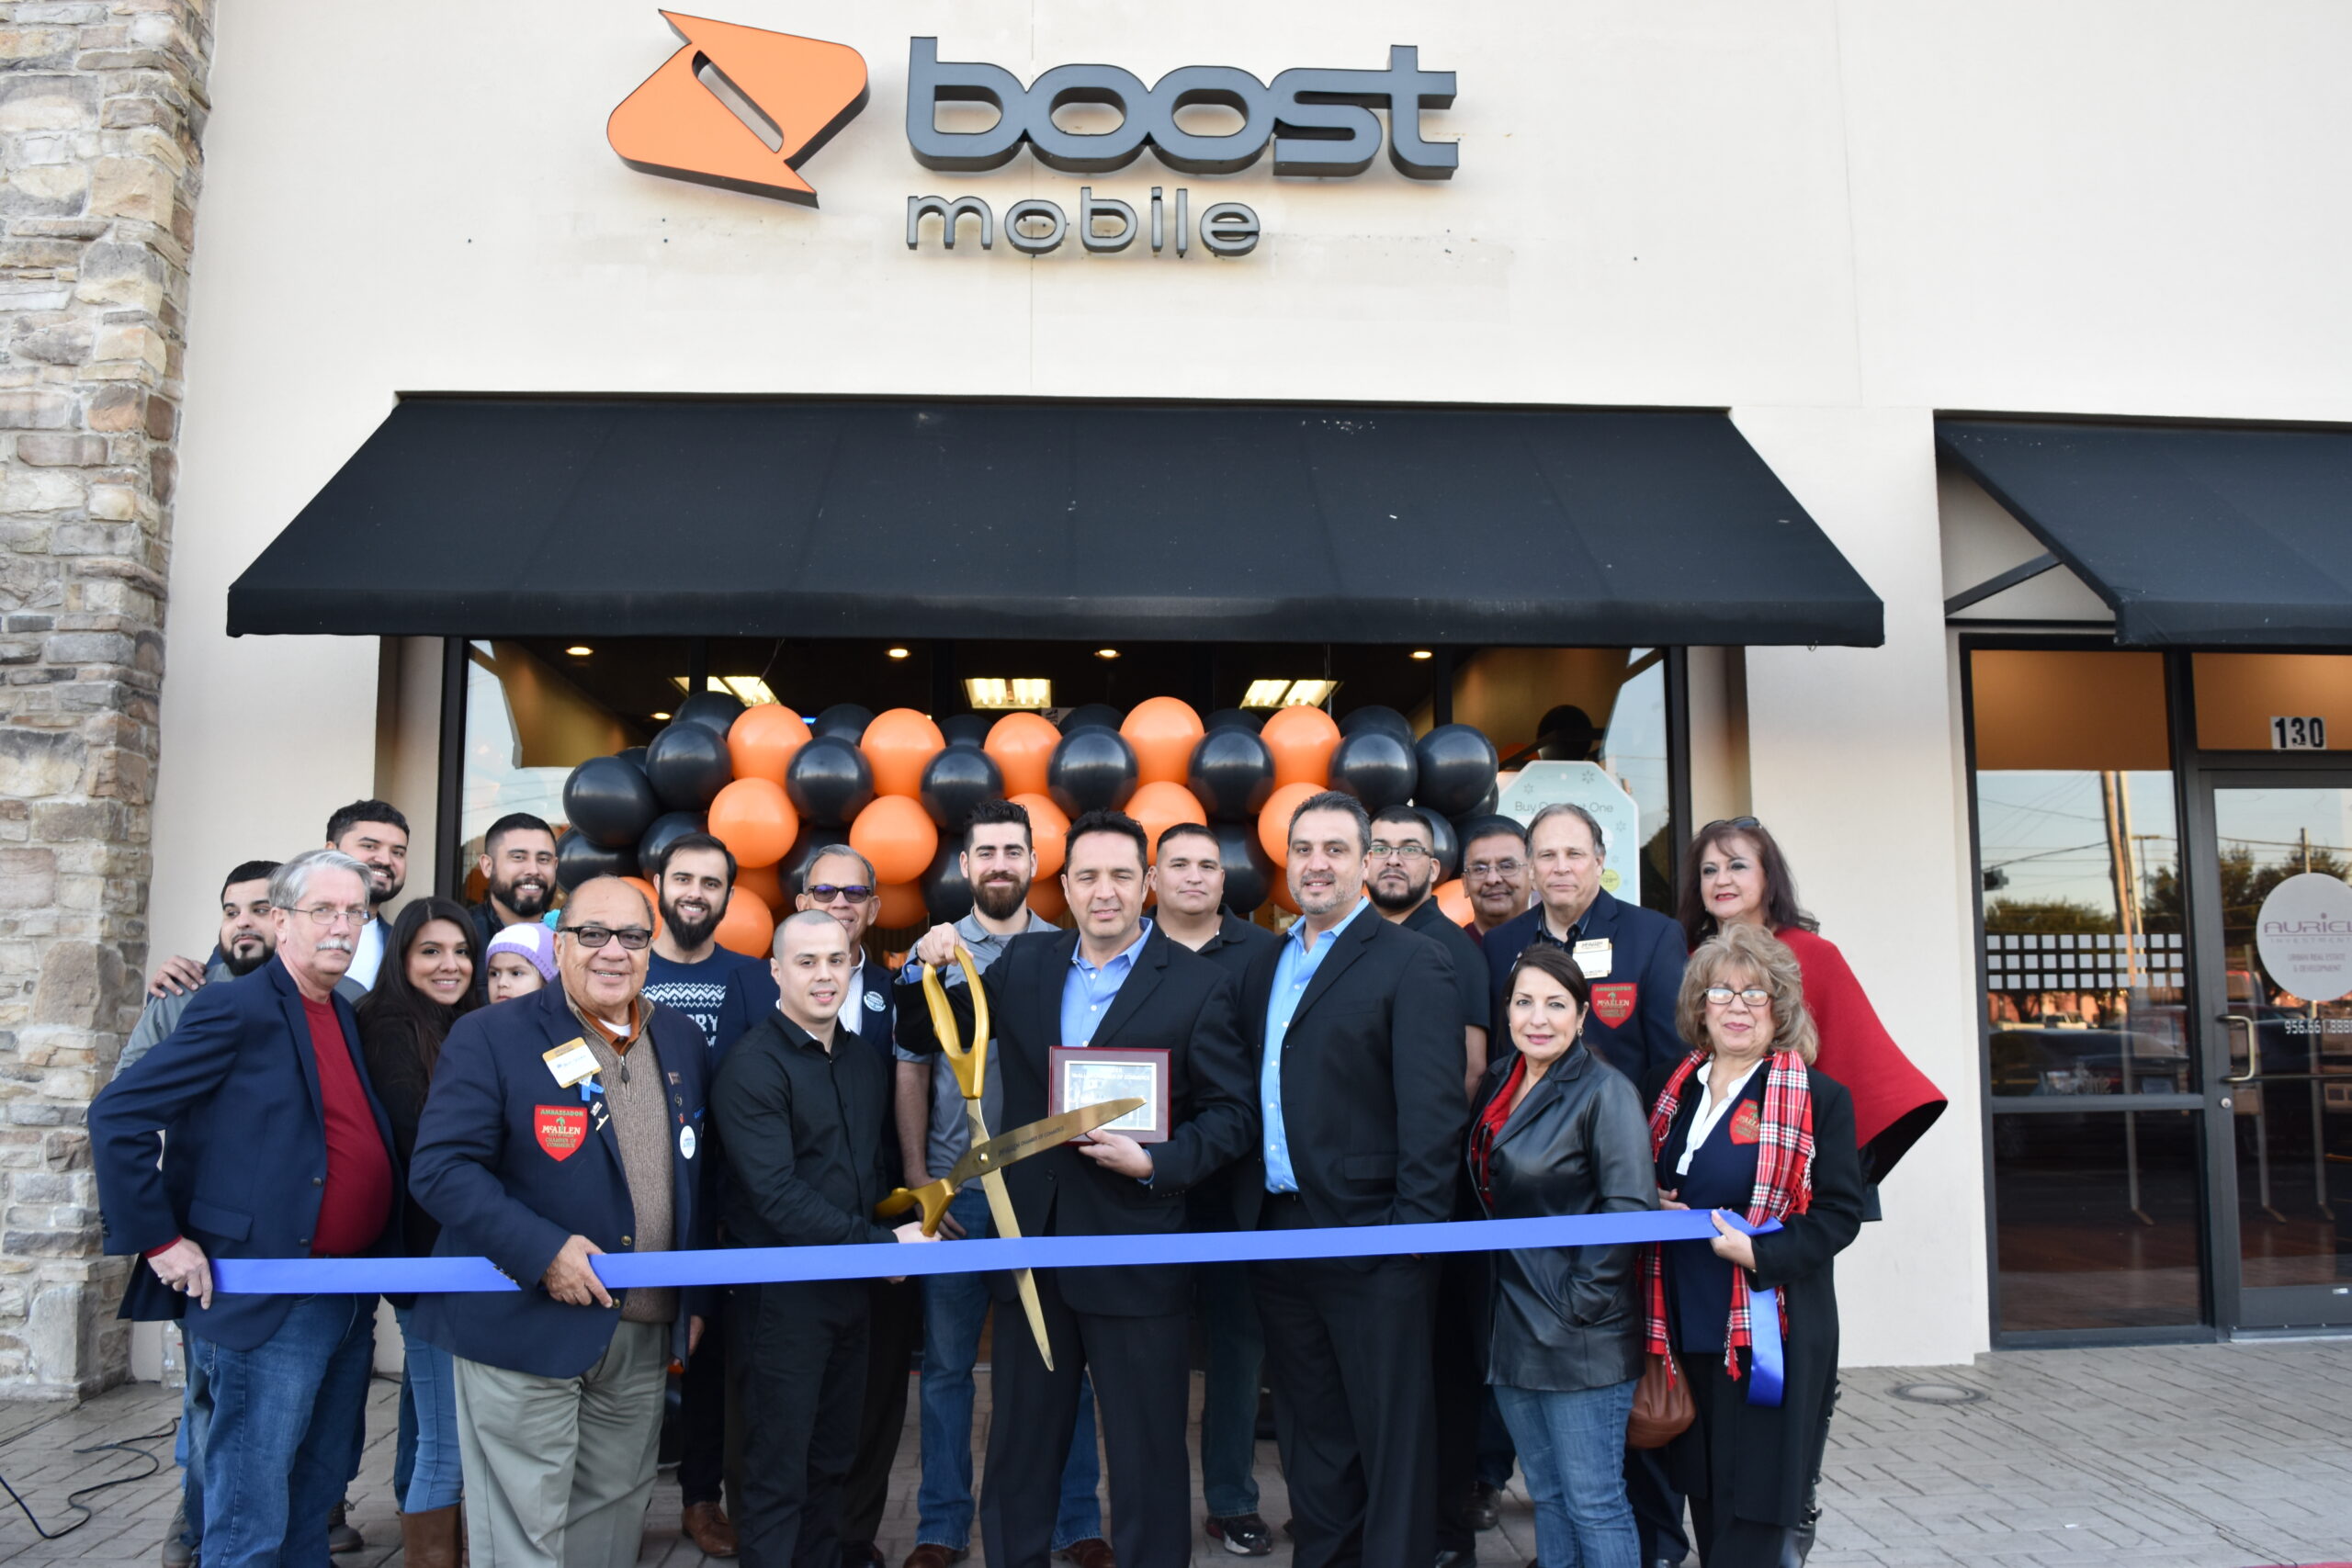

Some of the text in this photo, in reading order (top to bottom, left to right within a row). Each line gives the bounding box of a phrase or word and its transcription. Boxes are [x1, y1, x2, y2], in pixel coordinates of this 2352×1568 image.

[906, 37, 1459, 180] boost
[907, 186, 1261, 255] mobile
[2274, 717, 2324, 748] 130
[1514, 801, 1537, 814] Buy
[1589, 802, 1614, 813] One
